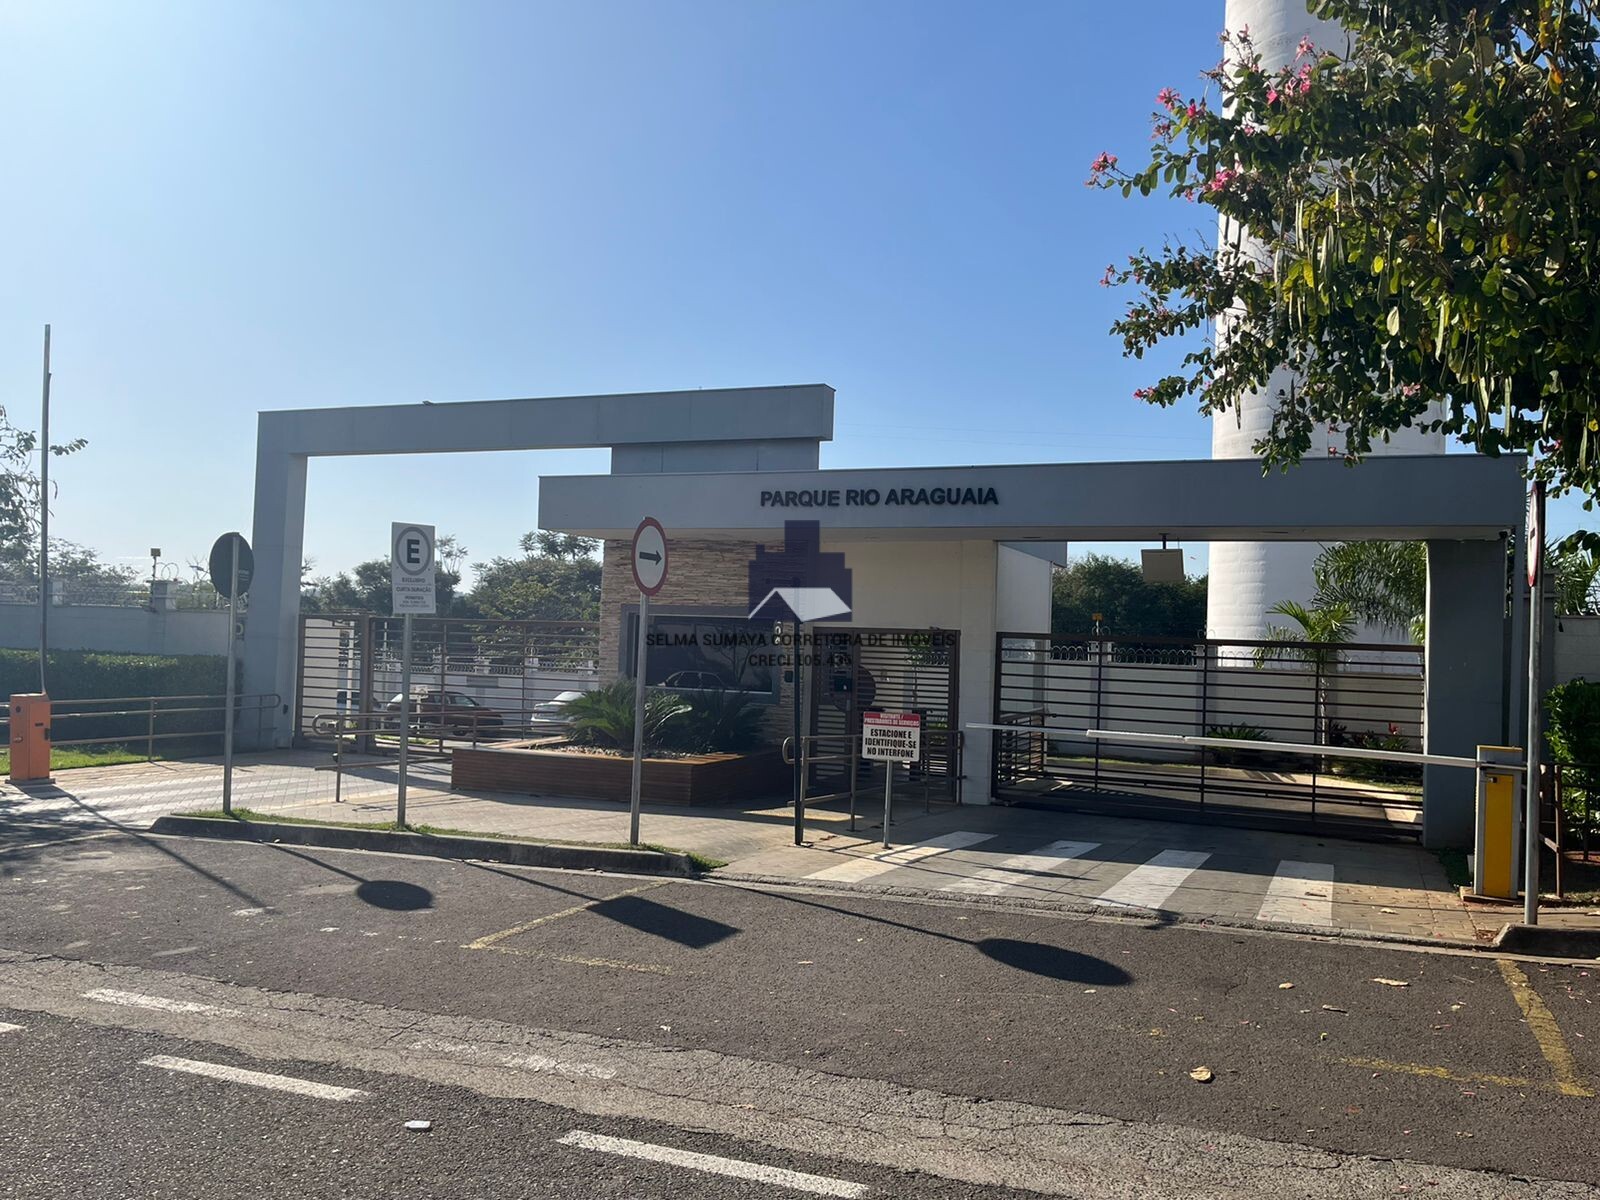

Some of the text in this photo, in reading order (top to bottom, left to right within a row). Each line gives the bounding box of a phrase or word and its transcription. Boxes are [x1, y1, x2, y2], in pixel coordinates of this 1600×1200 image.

[760, 487, 999, 508] PARQUE RIO ARAGUAIA
[406, 538, 420, 564] E
[870, 728, 912, 739] ESTACIONE E
[865, 737, 917, 749] IDENTIFIQUE-SE
[867, 747, 914, 758] NO INTERFONE
